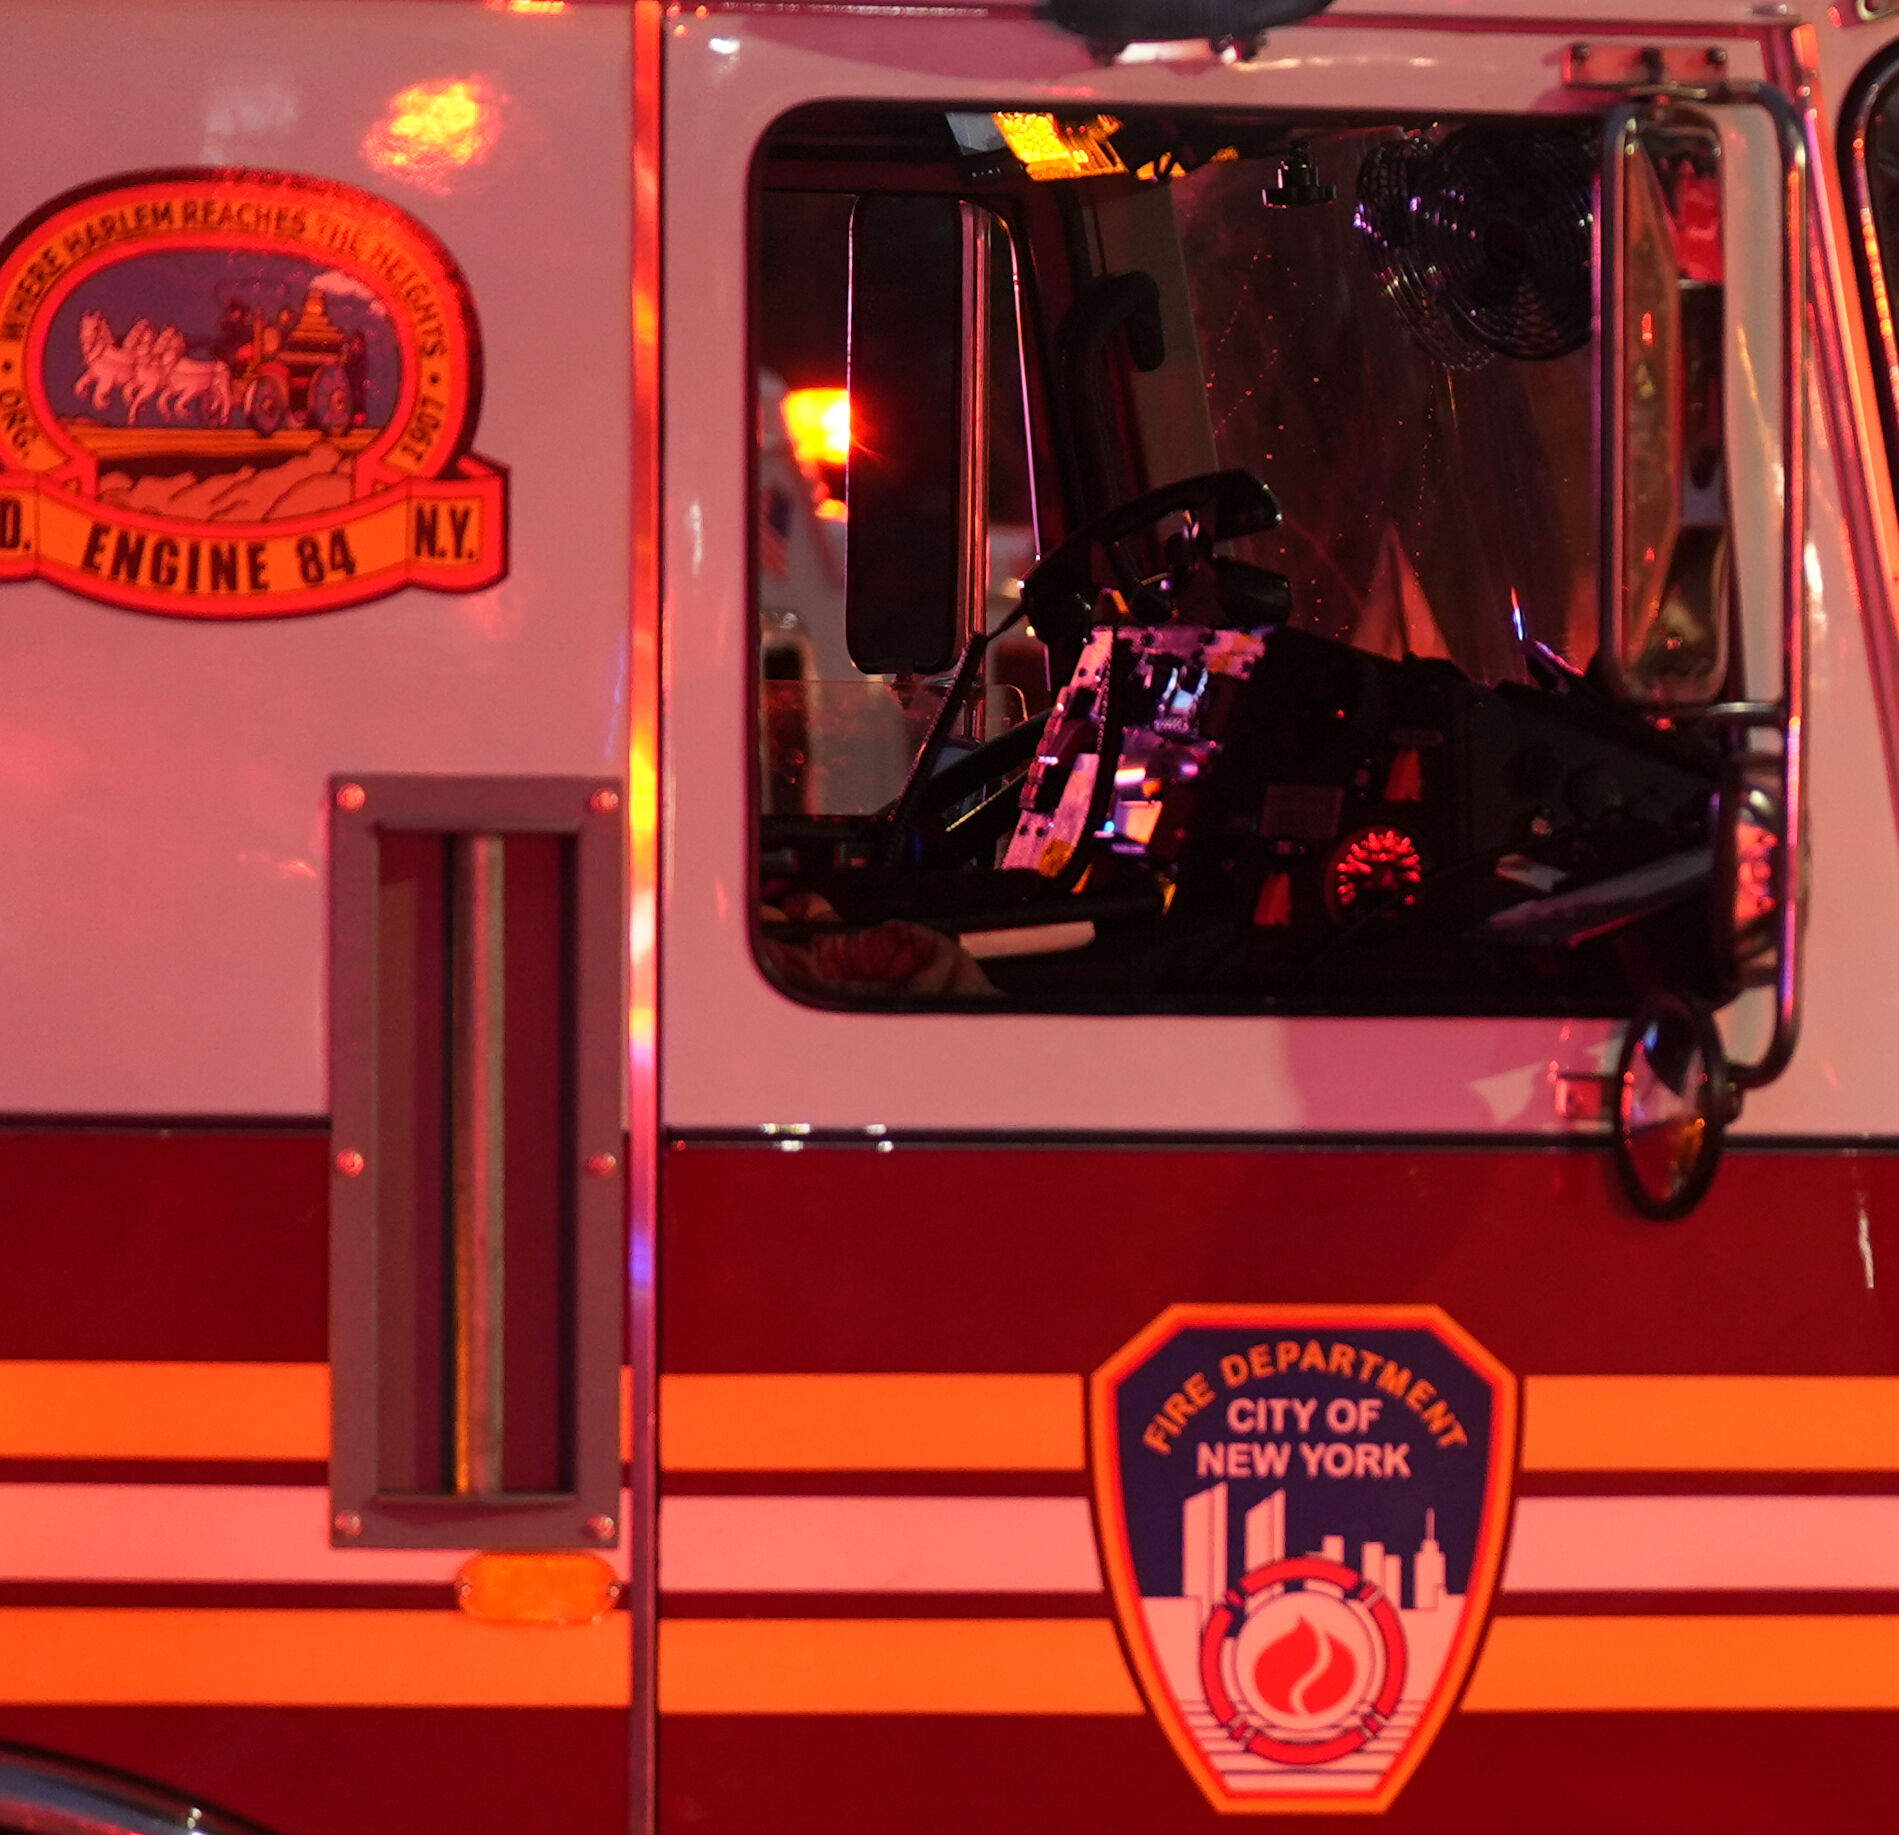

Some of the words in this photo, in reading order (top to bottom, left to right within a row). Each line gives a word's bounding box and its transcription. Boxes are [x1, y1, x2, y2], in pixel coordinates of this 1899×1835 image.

[63, 201, 175, 254] HARLEM
[182, 200, 307, 234] REACHES
[366, 240, 449, 358] HEIGHTS
[401, 396, 444, 463] 1907
[81, 522, 271, 593] ENGINE
[296, 525, 357, 587] 84
[415, 504, 476, 560] N.Y.
[1142, 1371, 1217, 1457] FIRE
[1219, 1339, 1469, 1451] DEPARTMENT
[1226, 1397, 1316, 1435] CITY
[1325, 1397, 1385, 1435] OF
[1197, 1441, 1292, 1478] NEW
[1300, 1441, 1413, 1478] YORK
